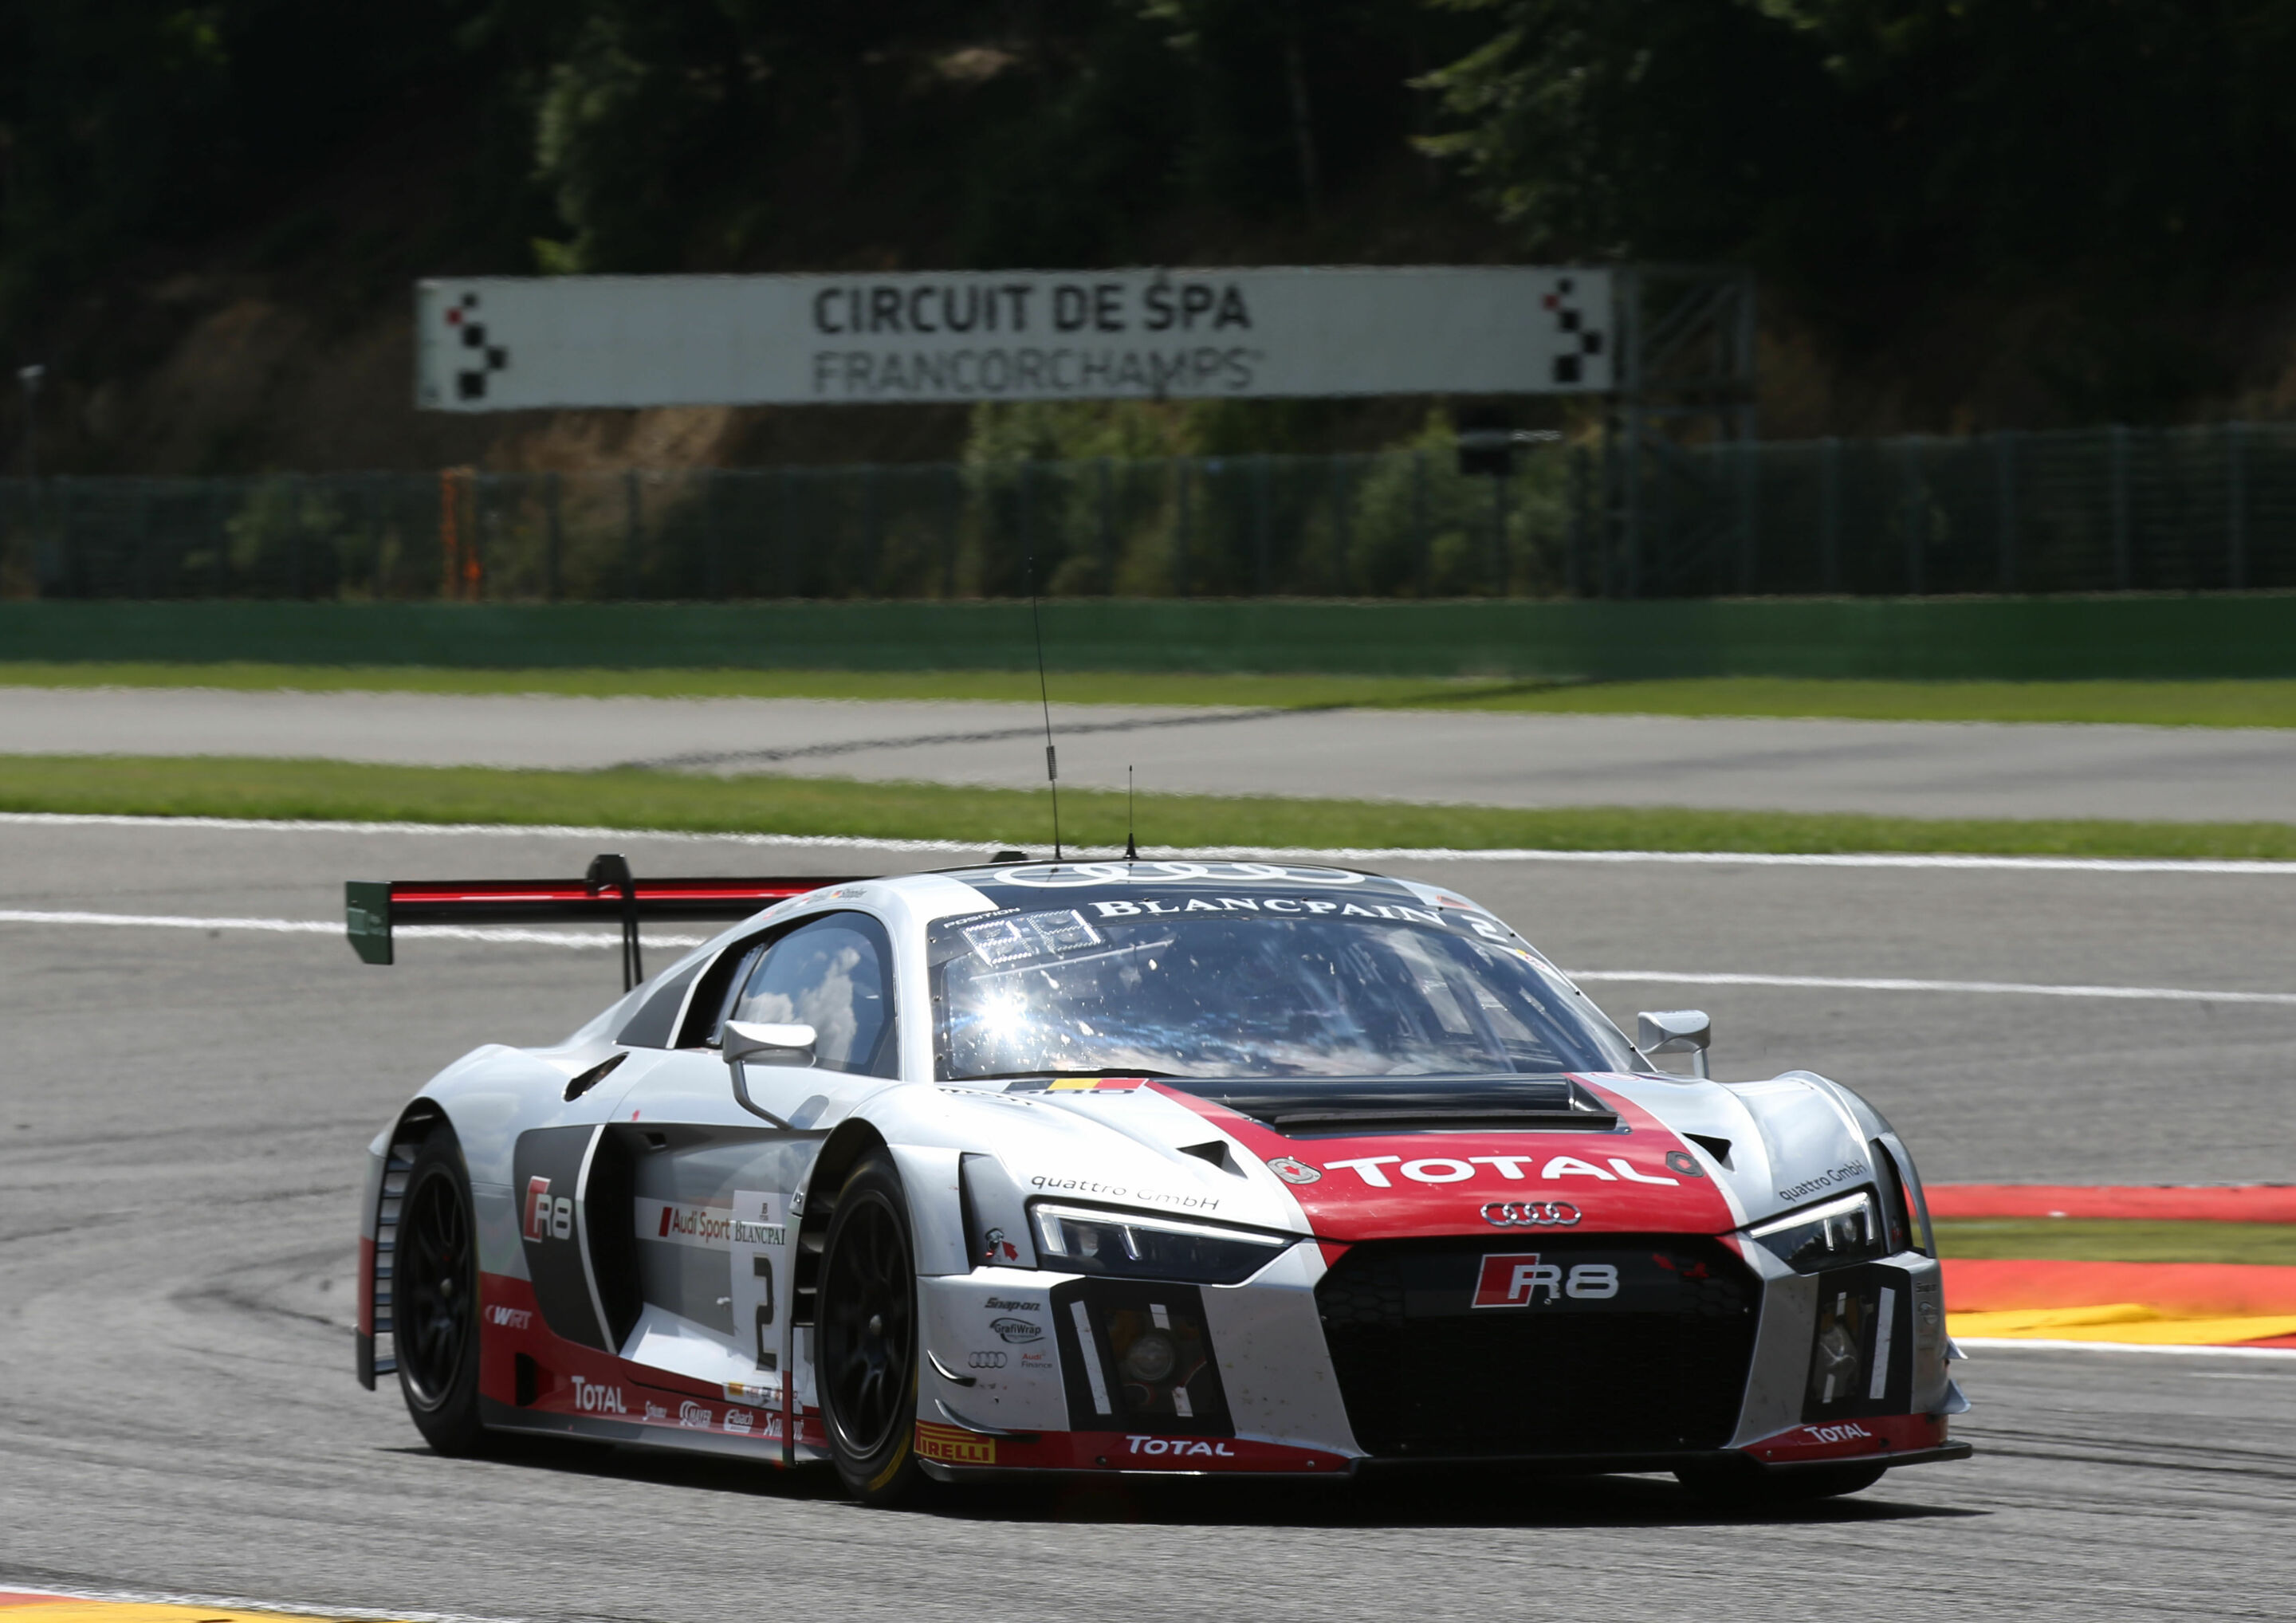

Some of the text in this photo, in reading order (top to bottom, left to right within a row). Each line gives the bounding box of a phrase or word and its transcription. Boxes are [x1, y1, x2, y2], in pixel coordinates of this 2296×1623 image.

[812, 282, 1252, 334] CIRCUIT DE SPA
[812, 346, 1254, 395] FRANCORCHAMPS
[943, 906, 1021, 929] POSITION
[1087, 898, 1509, 943] BLANCPAIN 2
[1323, 1154, 1681, 1189] TOTAL
[1779, 1159, 1868, 1202] quattro GmbH
[1031, 1175, 1220, 1211] quattro GmbH
[532, 1191, 573, 1241] R8
[672, 1208, 731, 1244] Audi Sport
[735, 1220, 786, 1246] BLANCPAI
[492, 1305, 533, 1330] WRT
[753, 1256, 778, 1372] 2
[985, 1297, 1041, 1312] Snap-on
[994, 1323, 1042, 1336] GrafiWrap
[1021, 1360, 1053, 1369] Finance
[571, 1375, 627, 1414] TOTAL
[1125, 1435, 1236, 1457] TOTAL
[1803, 1422, 1872, 1444] TOTAL
